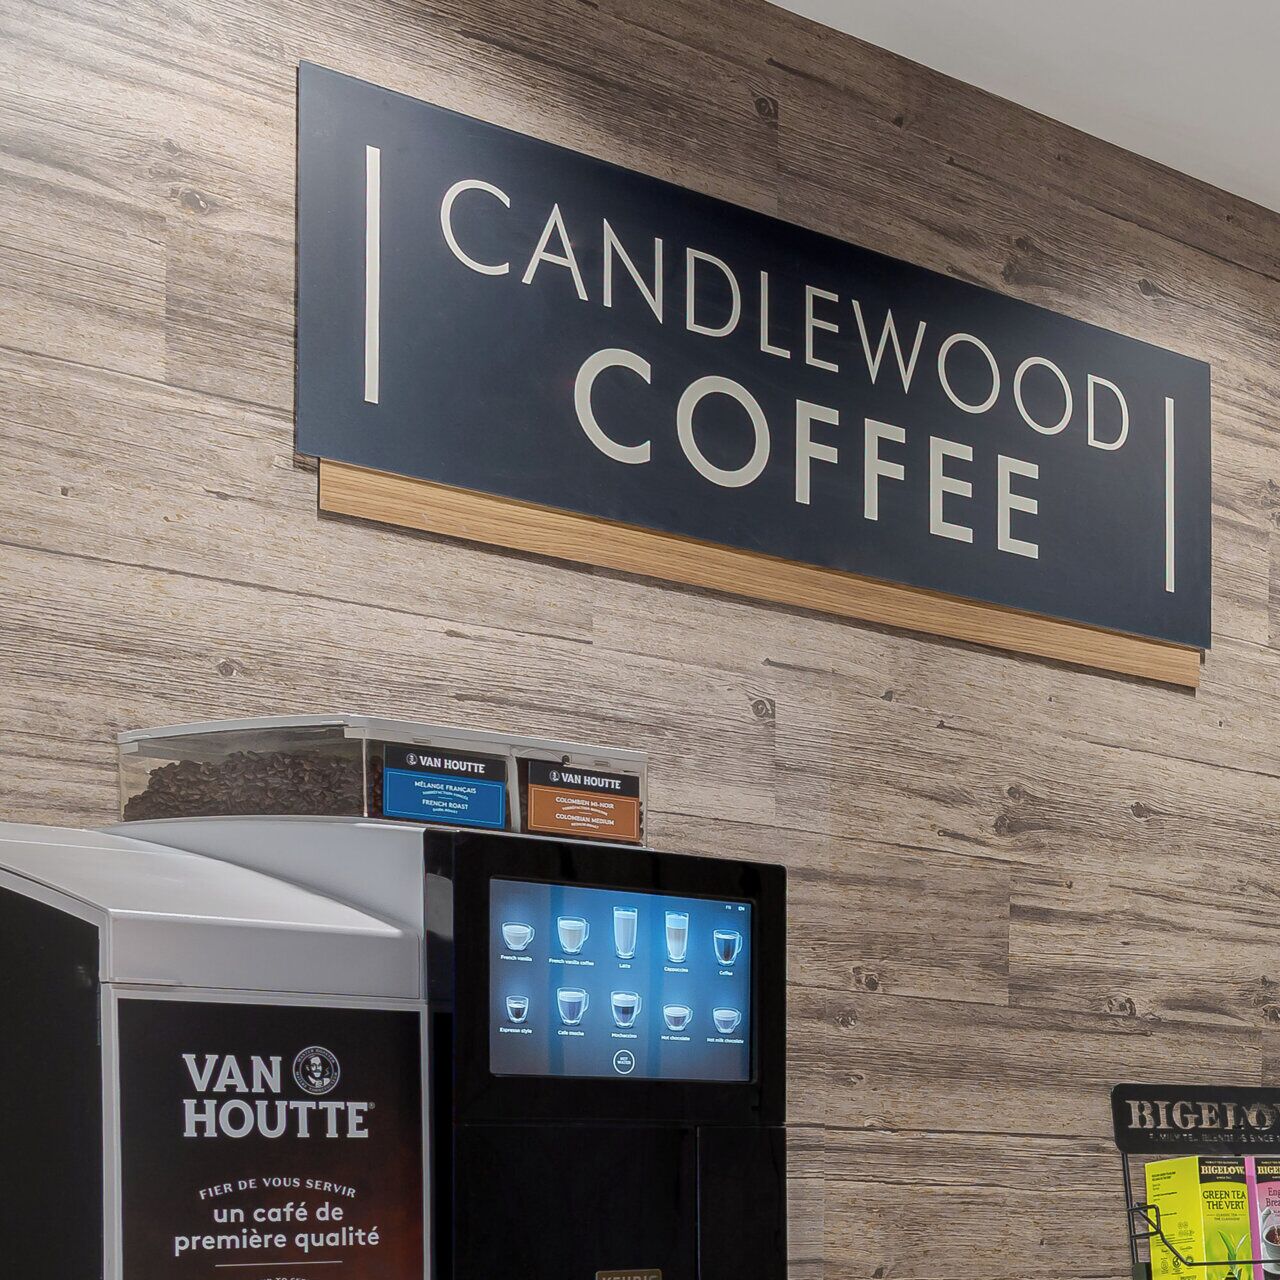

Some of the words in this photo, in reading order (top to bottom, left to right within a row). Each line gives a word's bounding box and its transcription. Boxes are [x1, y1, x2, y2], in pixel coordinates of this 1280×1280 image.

[439, 178, 1131, 453] CANDLEWOOD
[572, 348, 1041, 560] COFFEE
[419, 755, 441, 768] VAN
[444, 759, 486, 773] HOUTTE
[561, 772, 581, 784] VAN
[584, 776, 621, 789] HOUTTE
[181, 1053, 282, 1094] VAN
[199, 1183, 232, 1200] FIER
[238, 1178, 257, 1190] DE
[263, 1177, 300, 1187] VOUS
[305, 1178, 357, 1198] SERVIR
[1203, 1191, 1230, 1199] GREEN
[1232, 1191, 1246, 1199] TEA
[214, 1208, 244, 1223] un
[253, 1202, 308, 1222] café
[316, 1202, 344, 1221] de
[1221, 1201, 1244, 1209] VERT
[175, 1228, 287, 1257] première
[295, 1226, 380, 1253] qualité
